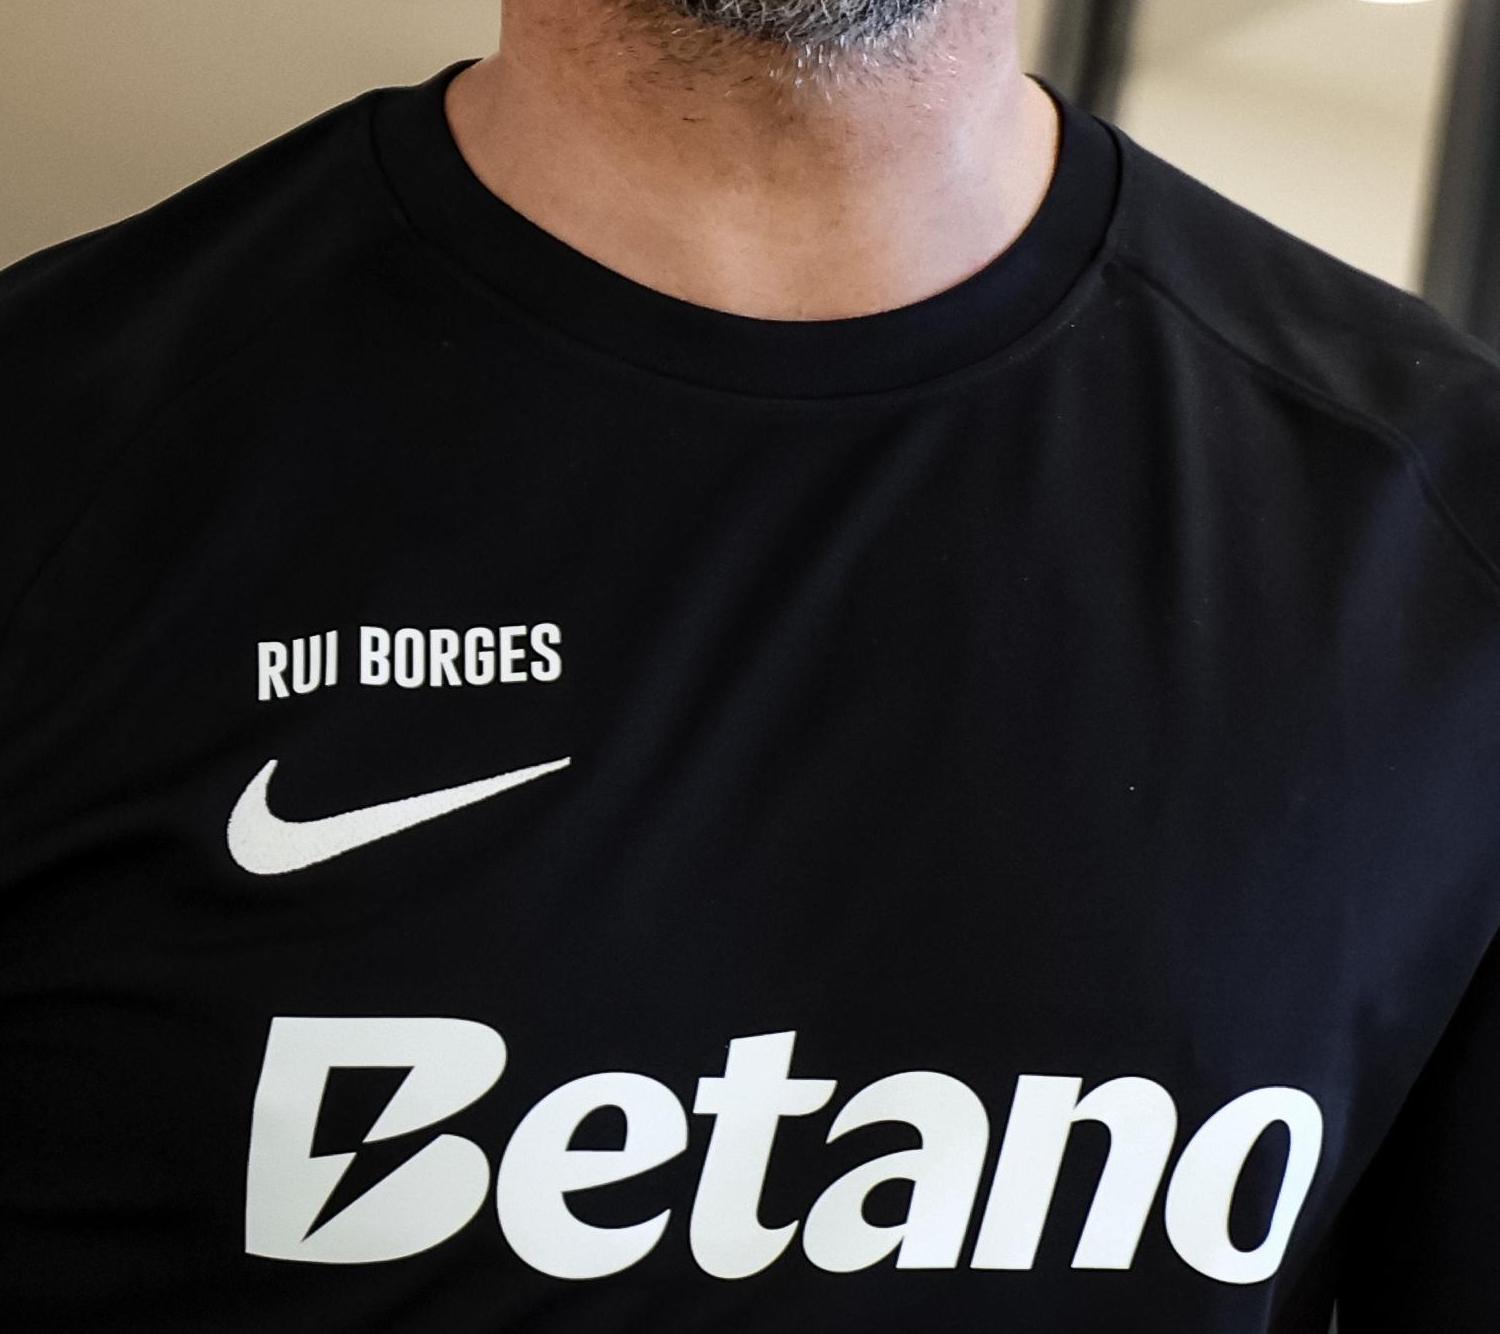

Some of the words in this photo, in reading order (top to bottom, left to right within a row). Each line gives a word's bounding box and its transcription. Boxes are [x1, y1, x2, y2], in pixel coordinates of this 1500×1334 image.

[257, 630, 339, 701] RUI
[360, 622, 563, 689] BORGES
[244, 1016, 1324, 1285] Betano
